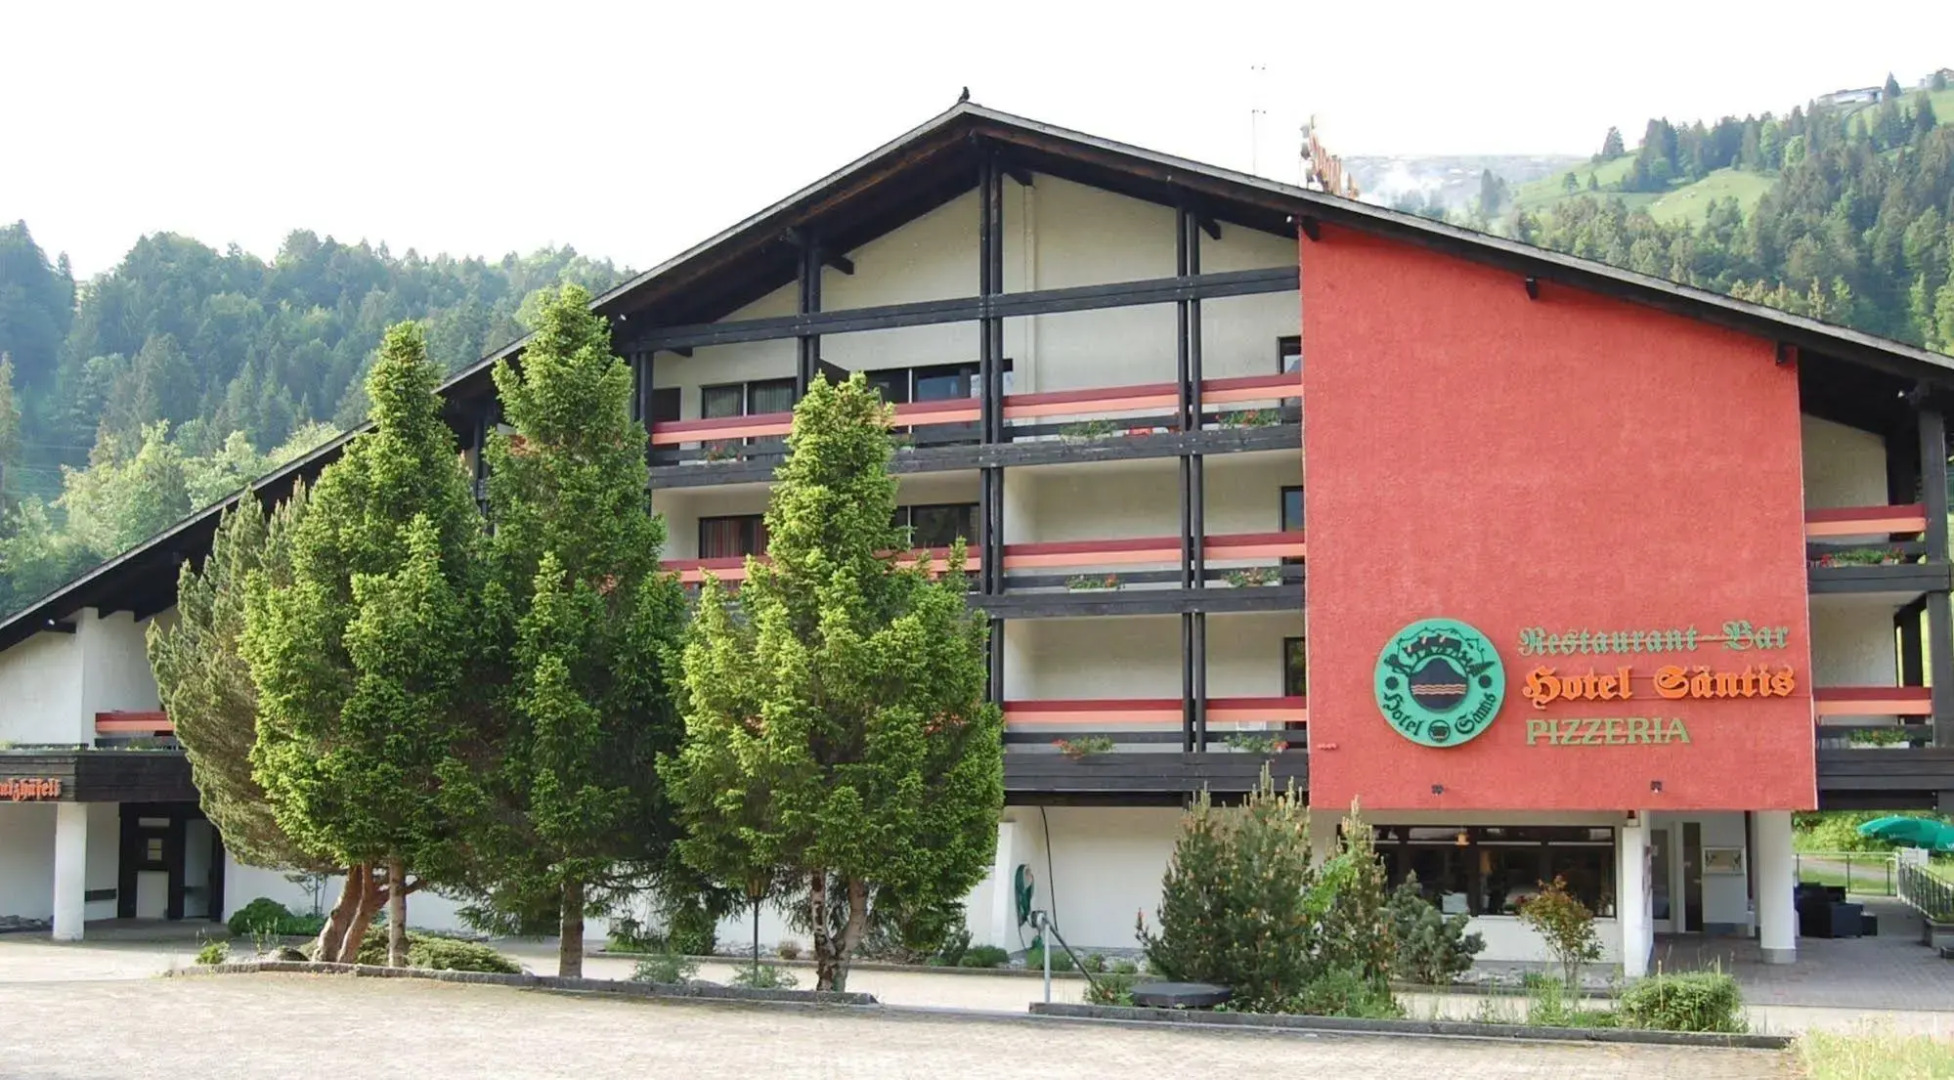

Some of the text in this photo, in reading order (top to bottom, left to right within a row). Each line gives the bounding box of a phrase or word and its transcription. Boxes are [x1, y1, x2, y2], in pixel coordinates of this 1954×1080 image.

[1522, 664, 1796, 710] Hotel Säntis
[1382, 692, 1425, 736] Hotel
[1526, 717, 1690, 745] PIZZERIA
